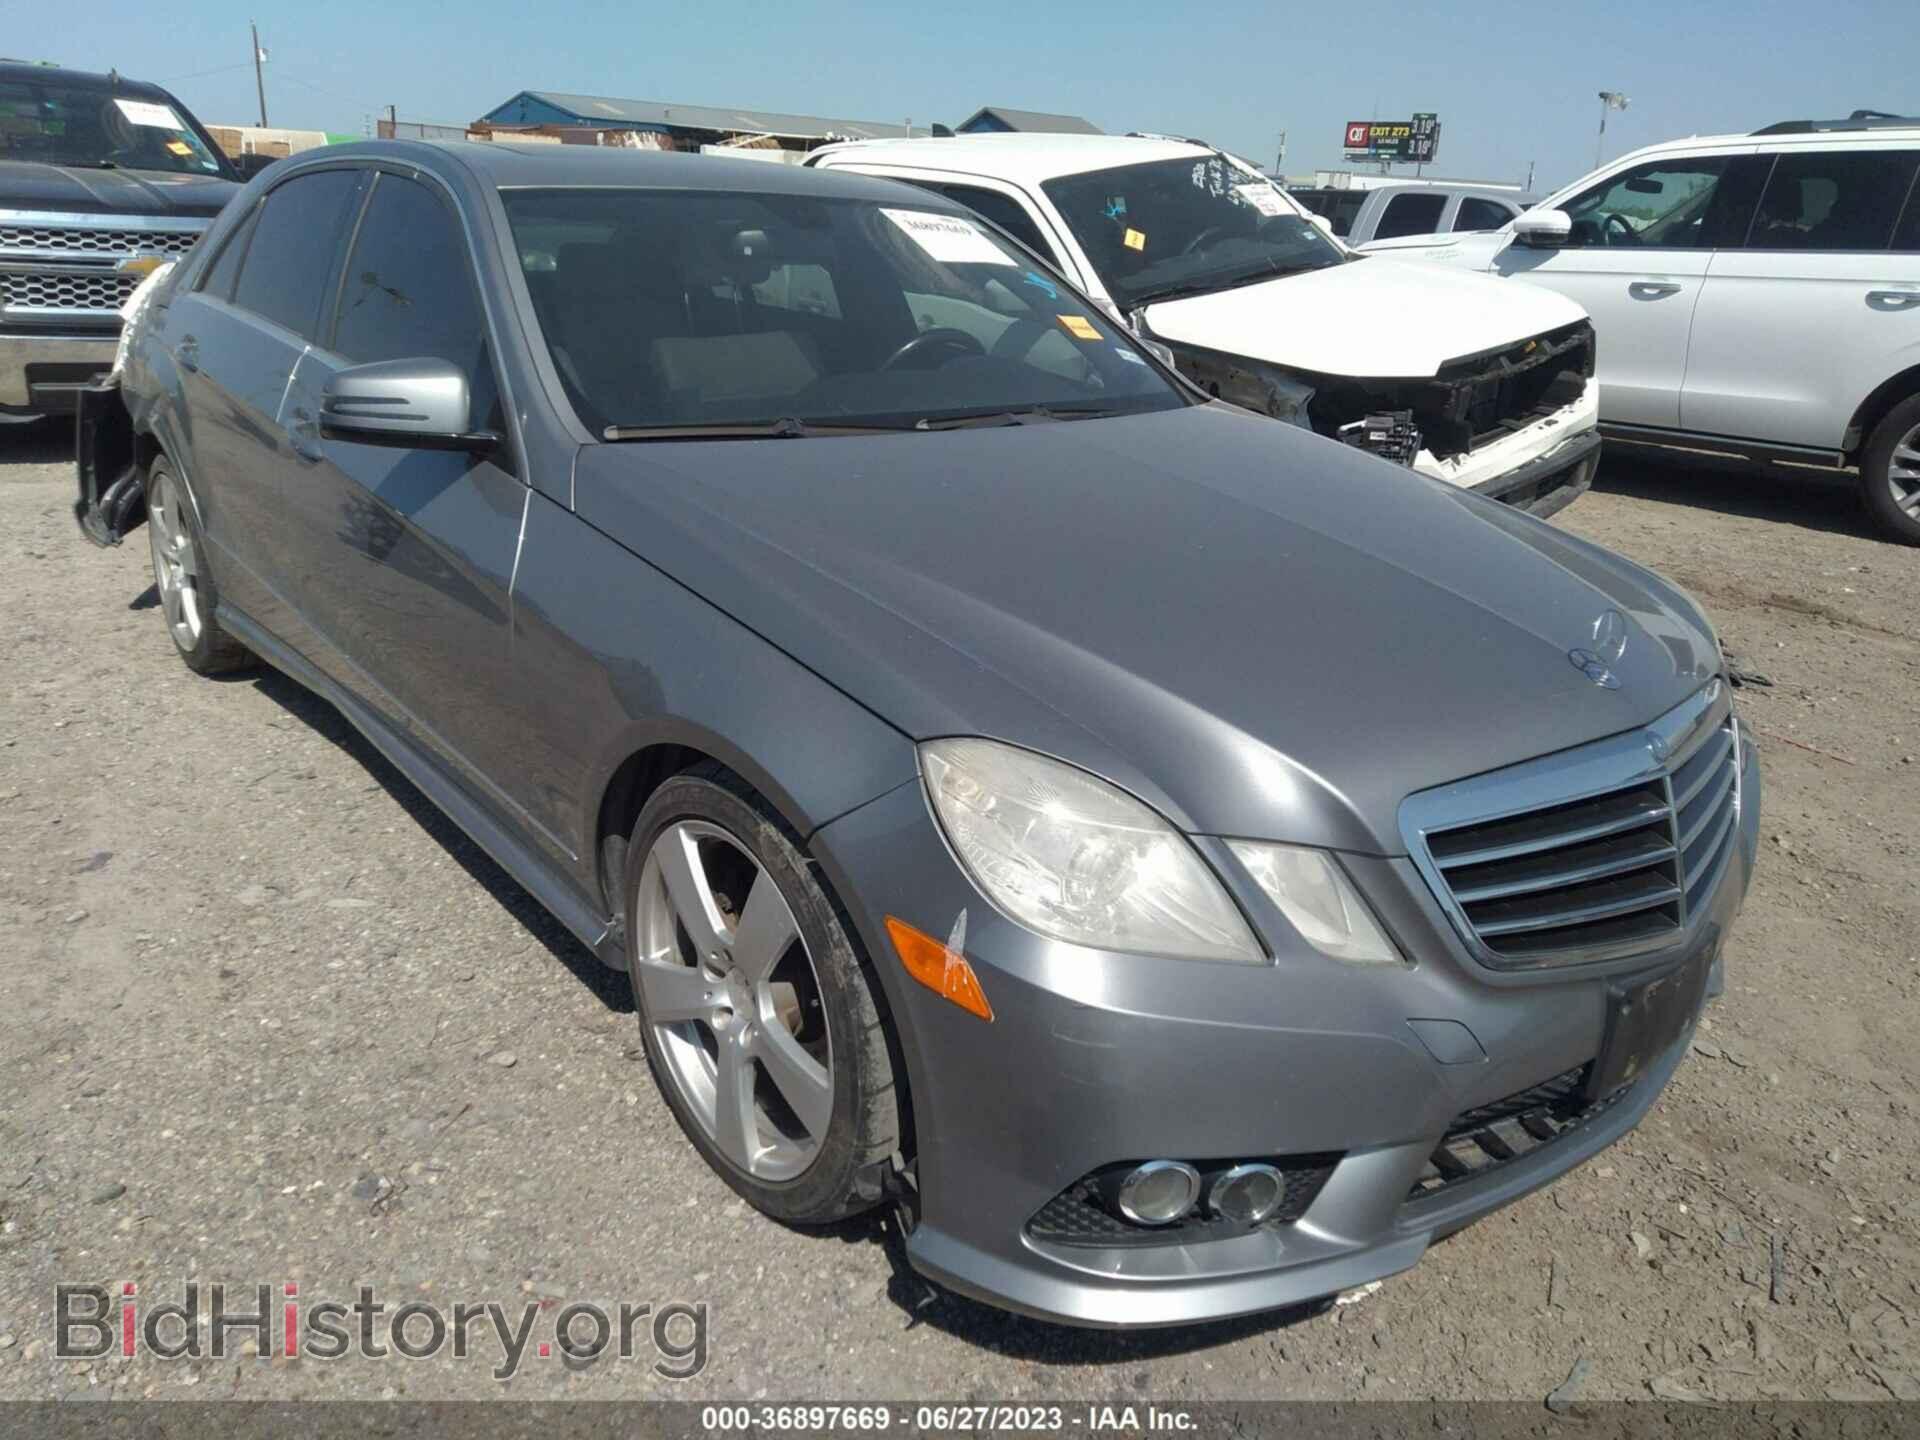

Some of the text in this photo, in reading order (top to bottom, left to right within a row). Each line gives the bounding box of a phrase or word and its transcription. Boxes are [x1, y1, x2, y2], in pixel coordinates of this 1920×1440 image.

[1348, 127, 1366, 142] QT
[1369, 127, 1391, 137] EXIT
[1391, 127, 1410, 137] 273
